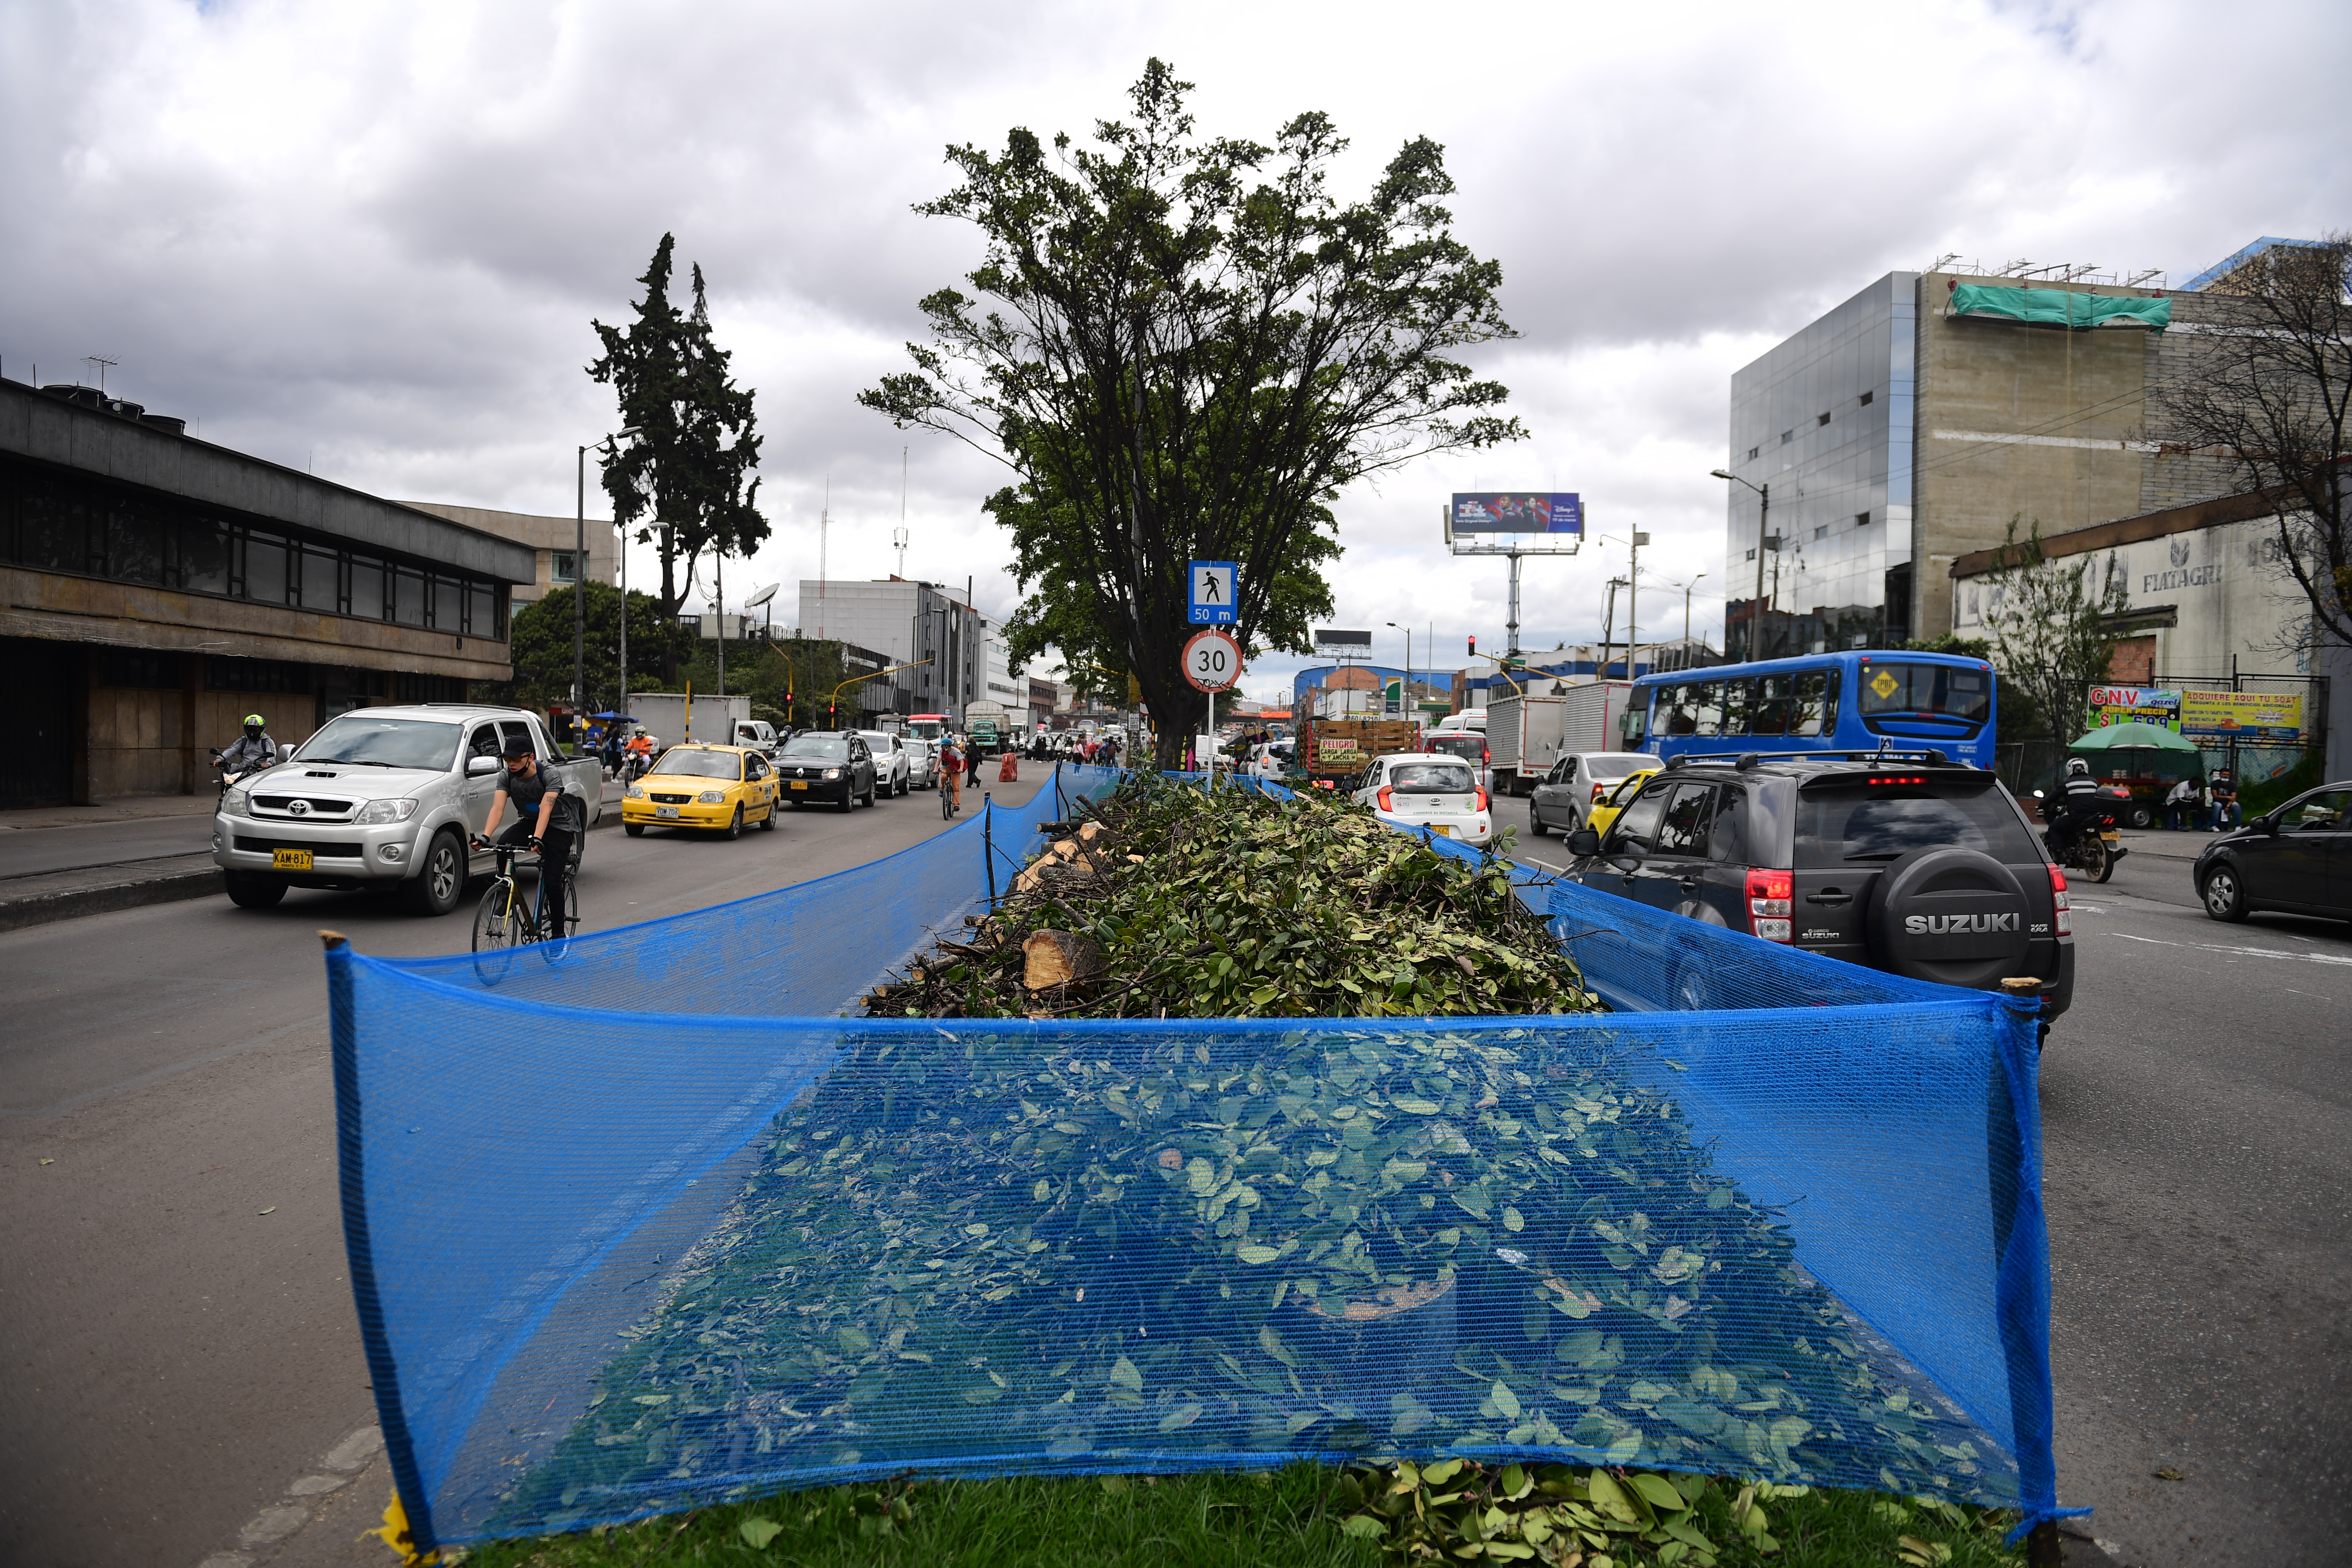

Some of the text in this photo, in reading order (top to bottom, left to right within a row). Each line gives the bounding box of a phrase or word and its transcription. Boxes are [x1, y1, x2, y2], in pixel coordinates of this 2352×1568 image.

[1195, 609, 1230, 621] 50 m
[1198, 650, 1225, 672] 30
[2151, 698, 2178, 706] gazel
[2187, 693, 2230, 701] ADQUIERE
[2102, 705, 2168, 716] SUPER PRECIO
[1323, 740, 1355, 749] PELIGRO
[274, 852, 311, 864] KAM-817
[1905, 913, 2020, 935] SUZUKI
